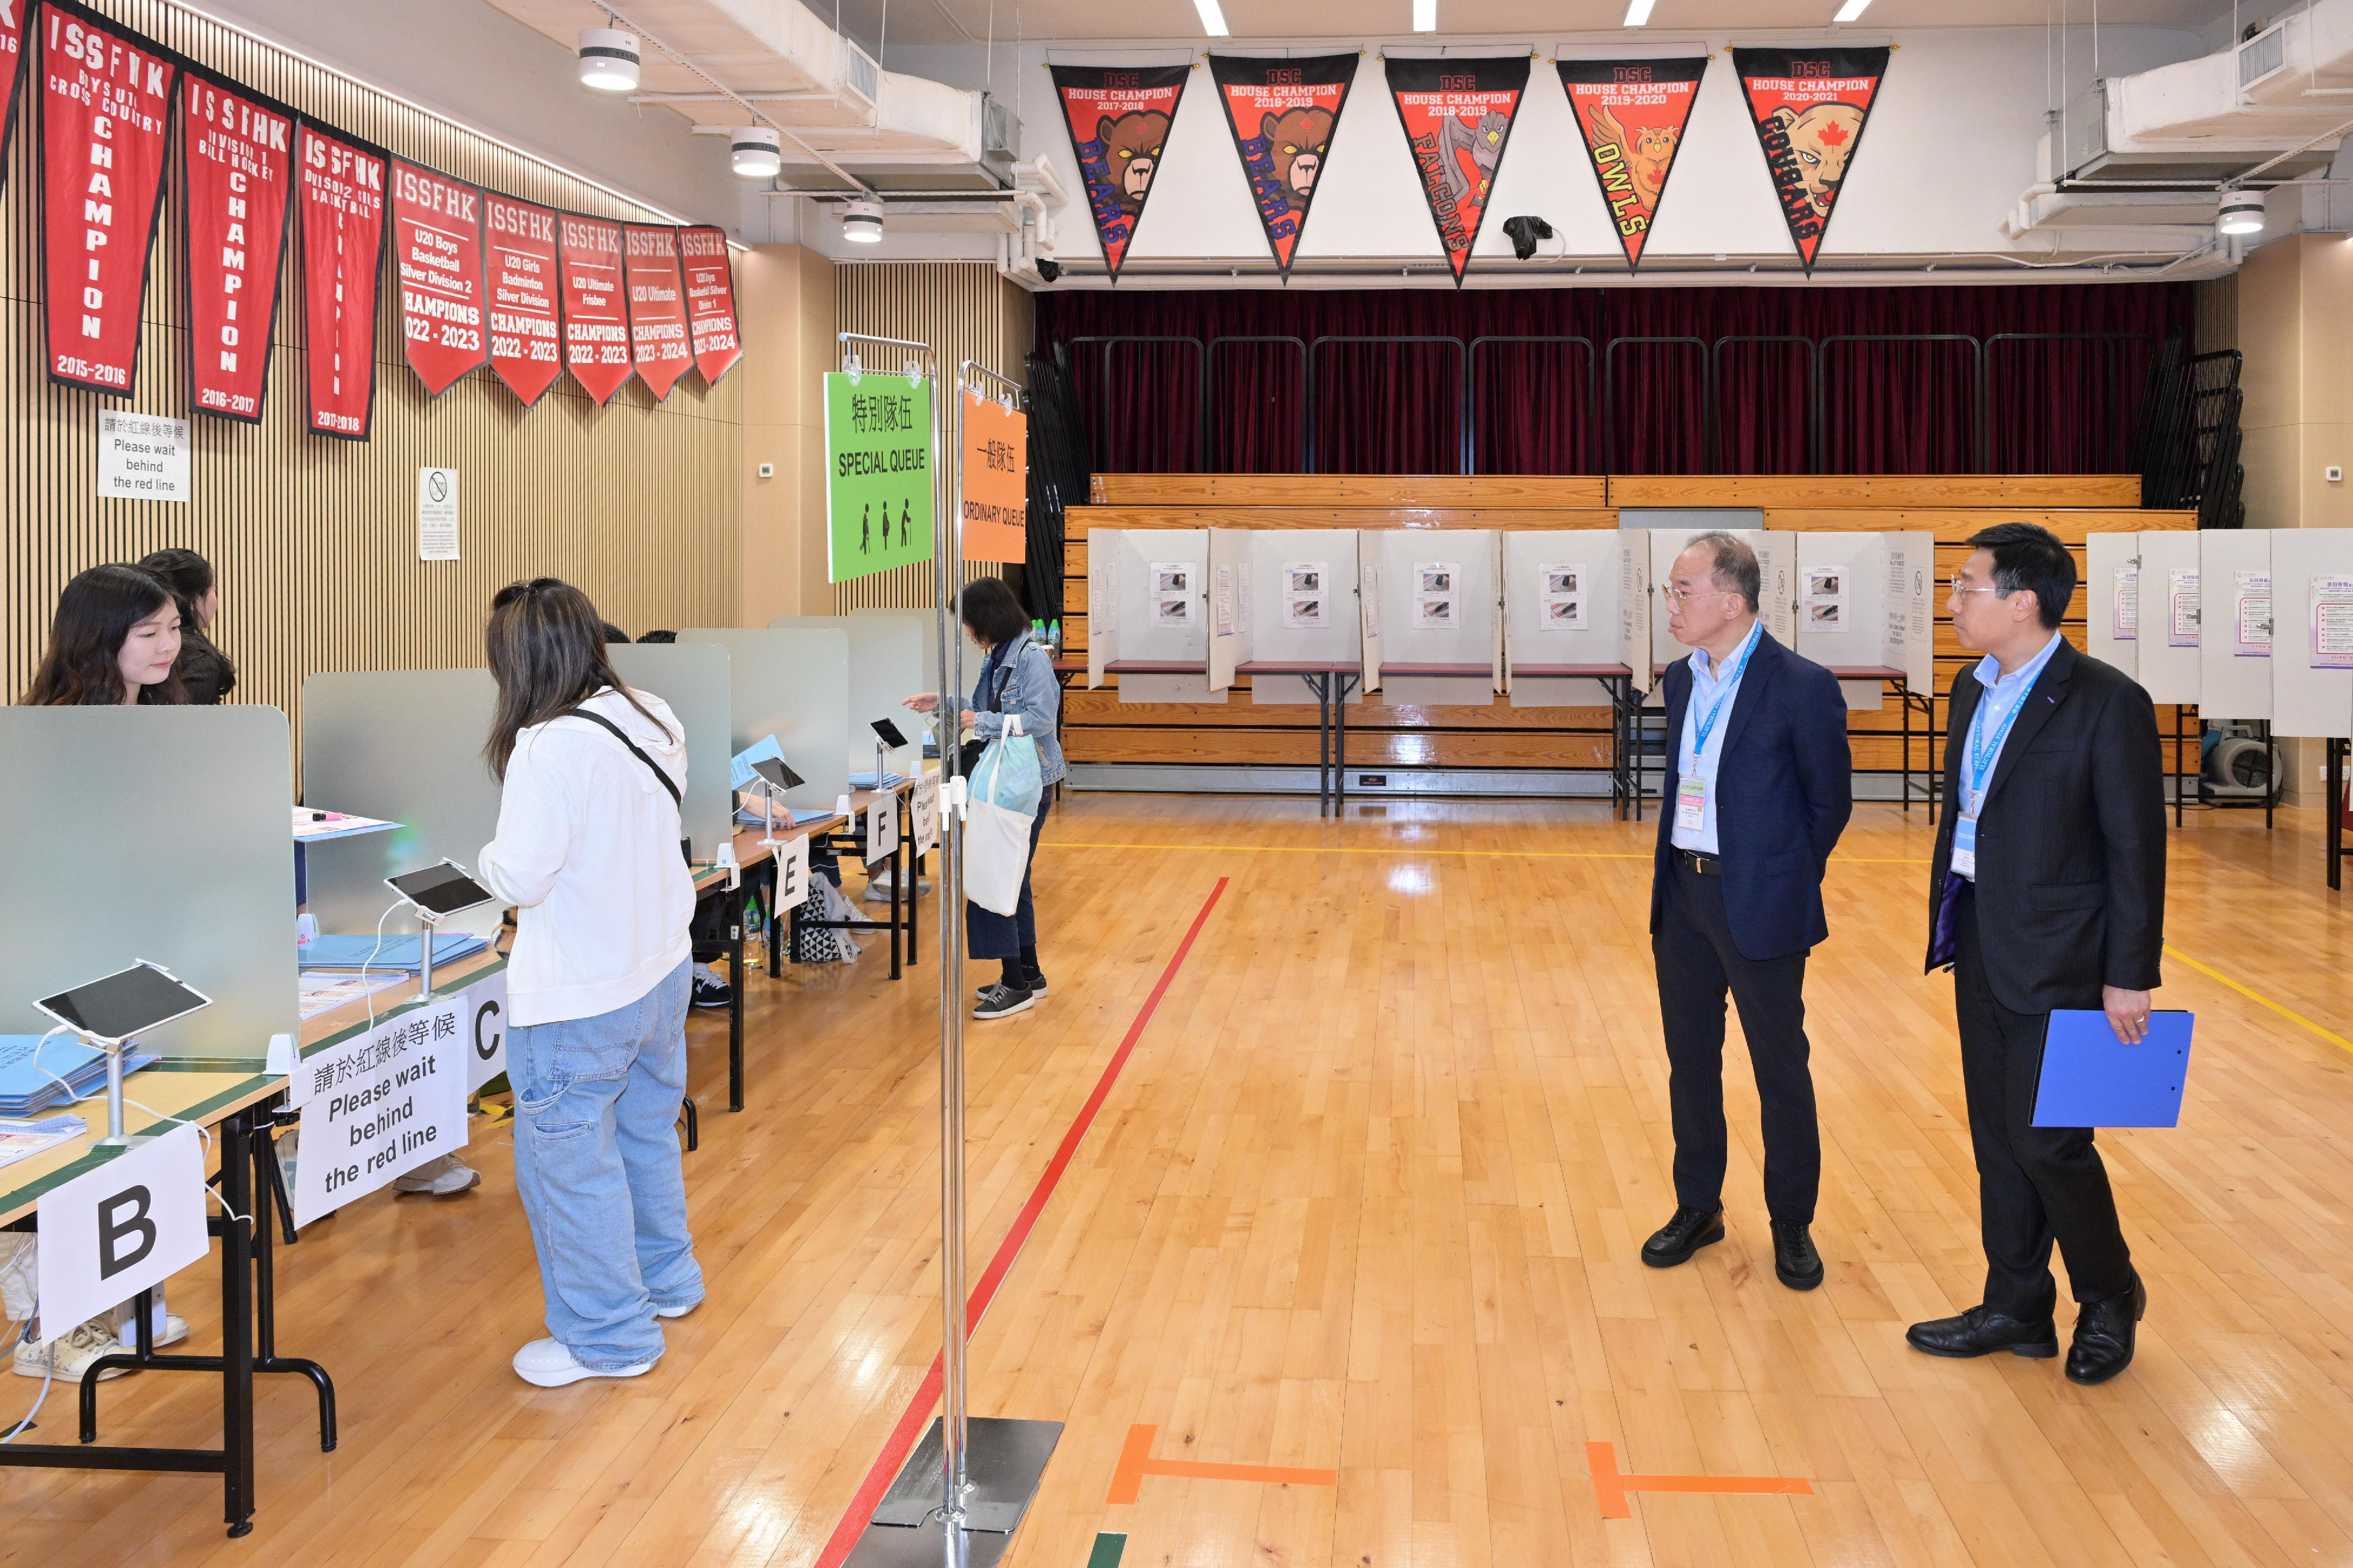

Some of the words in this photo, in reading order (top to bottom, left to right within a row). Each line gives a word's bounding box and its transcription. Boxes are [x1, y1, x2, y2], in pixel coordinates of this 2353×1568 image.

[1104, 72, 1138, 89] DSC
[1266, 68, 1302, 85] DSC
[1614, 67, 1652, 83] DSC
[1791, 61, 1830, 78] DSC
[50, 75, 91, 106] CROSS
[1068, 88, 1107, 101] HOUSE
[1109, 87, 1173, 101] CHAMPION
[1231, 85, 1270, 98] HOUSE
[1273, 85, 1337, 98] CHAMPION
[1440, 75, 1475, 92] DSC
[1576, 83, 1618, 95] HOUSE
[1622, 82, 1689, 94] CHAMPION
[1752, 78, 1796, 91] HOUSE
[1798, 79, 1868, 92] CHAMPION
[1783, 92, 1838, 101] 2020-2021
[1097, 101, 1144, 111] 2017-2018
[1254, 97, 1314, 108] 2018-2019
[1404, 94, 1443, 106] HOUSE
[1445, 92, 1511, 106] CHAMPION
[1428, 106, 1487, 116] 2018-2019
[1601, 94, 1667, 106] 2019-2020
[192, 84, 286, 152] ISSFHK
[305, 134, 381, 191] ISSFHK
[1078, 138, 1129, 245] BEARS
[1242, 134, 1296, 241] BEARS
[1595, 142, 1648, 237] OWLS
[1762, 116, 1821, 241] COUGARS
[395, 168, 475, 224] ISSFHK
[1413, 133, 1469, 253] FALCONS
[82, 116, 112, 339] CHAMPION
[487, 200, 554, 243] ISSFHK
[415, 228, 434, 246] U20
[435, 235, 458, 255] Boys
[562, 221, 618, 253] ISSFHK
[625, 230, 676, 257] ISSFHK
[681, 233, 725, 256] ISSFHK
[412, 246, 459, 272] Basketball
[505, 255, 521, 269] U20
[522, 258, 540, 273] Girls
[219, 172, 246, 373] CHAMPION
[401, 262, 426, 281] Silver
[428, 270, 463, 292] Division
[465, 280, 472, 293] 2
[502, 271, 543, 291] Badminton
[573, 276, 586, 290] U20
[587, 278, 614, 293] Ultimate
[496, 288, 519, 303] Silver
[521, 292, 549, 308] Division
[583, 293, 606, 307] Frisbee
[632, 286, 646, 302] U20
[648, 286, 676, 301] Ultimate
[709, 285, 727, 295] Silver
[712, 298, 716, 308] 1
[402, 291, 479, 326] HAMPIONS
[405, 316, 429, 342] 022
[441, 324, 480, 351] 2023
[491, 312, 557, 338] CHAMPIONS
[568, 323, 626, 342] CHAMPIONS
[634, 323, 684, 341] CHAMPIONS
[492, 336, 521, 358] 2022
[530, 340, 558, 362] 2023
[569, 345, 594, 363] 2022
[601, 345, 627, 363] 2023
[636, 343, 655, 363] 2023
[661, 342, 688, 360] 2024
[709, 334, 735, 351] 2024
[57, 355, 126, 385] 2015-2016
[202, 388, 255, 413] 2016-2017
[852, 393, 912, 434] 特別隊伍
[105, 417, 184, 439] 請於紅線後等候
[115, 439, 151, 453] Please
[154, 444, 175, 456] wait
[976, 438, 1015, 473] 一般隊伍
[126, 458, 163, 472] behind
[839, 451, 888, 477] SPECIAL
[890, 448, 925, 472] QUEUE
[114, 476, 131, 488] the
[135, 478, 152, 489] red
[156, 479, 175, 491] line
[964, 501, 1001, 523] ORDINARY
[1002, 510, 1025, 527] QUEUE
[1701, 707, 1718, 738] ELECTORAL
[1979, 738, 2000, 770] ELECTORAL
[878, 811, 886, 847] F
[785, 855, 796, 898] E
[475, 1000, 500, 1060] C
[314, 1012, 455, 1096] 請於紅線後等候
[329, 1079, 391, 1122] Please
[395, 1055, 435, 1087] wait
[350, 1096, 413, 1146] behind
[325, 1165, 358, 1193] the
[368, 1139, 396, 1174] red
[402, 1125, 436, 1155] line
[98, 1184, 157, 1282] B
